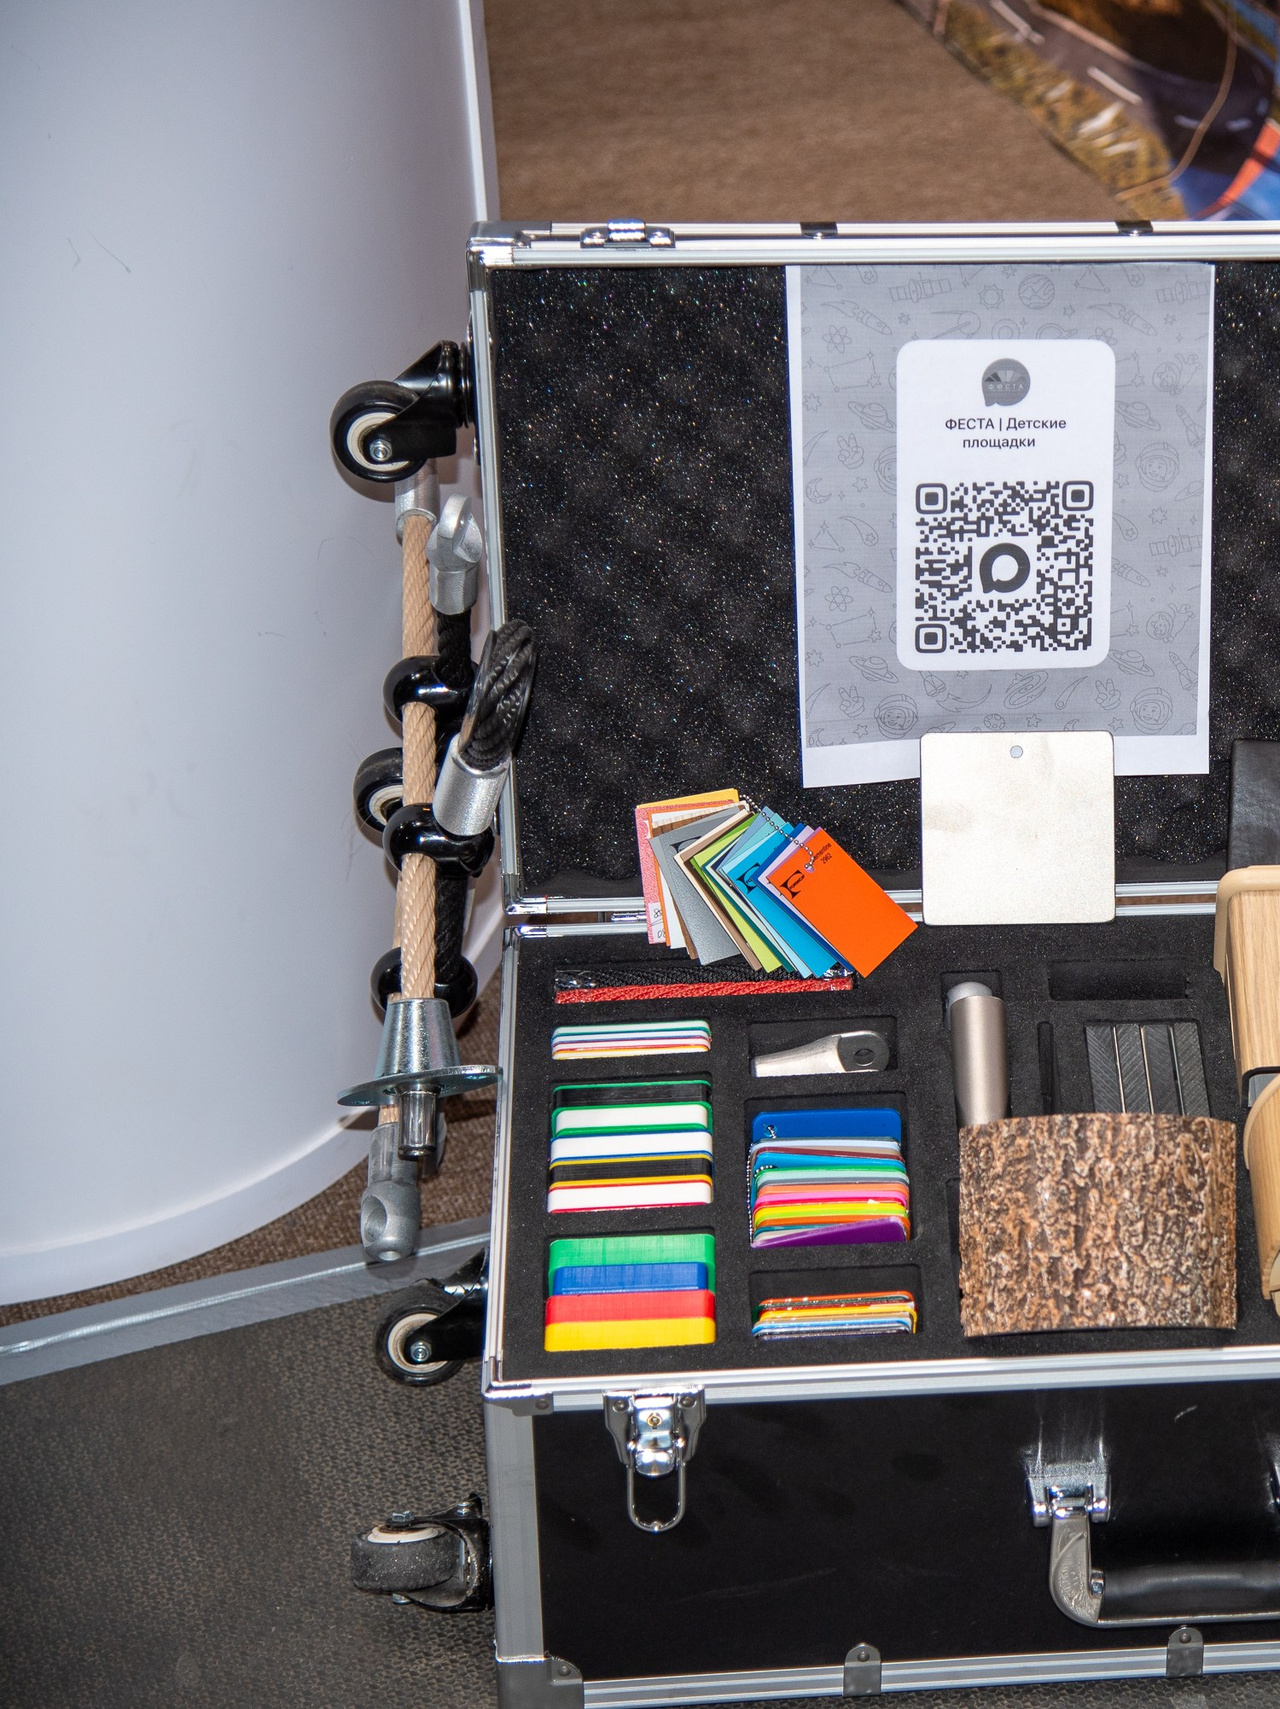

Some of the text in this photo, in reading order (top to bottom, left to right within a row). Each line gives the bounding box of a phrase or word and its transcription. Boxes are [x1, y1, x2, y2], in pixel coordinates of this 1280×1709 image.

[945, 418, 995, 430] ФЕСТА
[1006, 417, 1067, 431] Детские
[962, 438, 1036, 449] площадки
